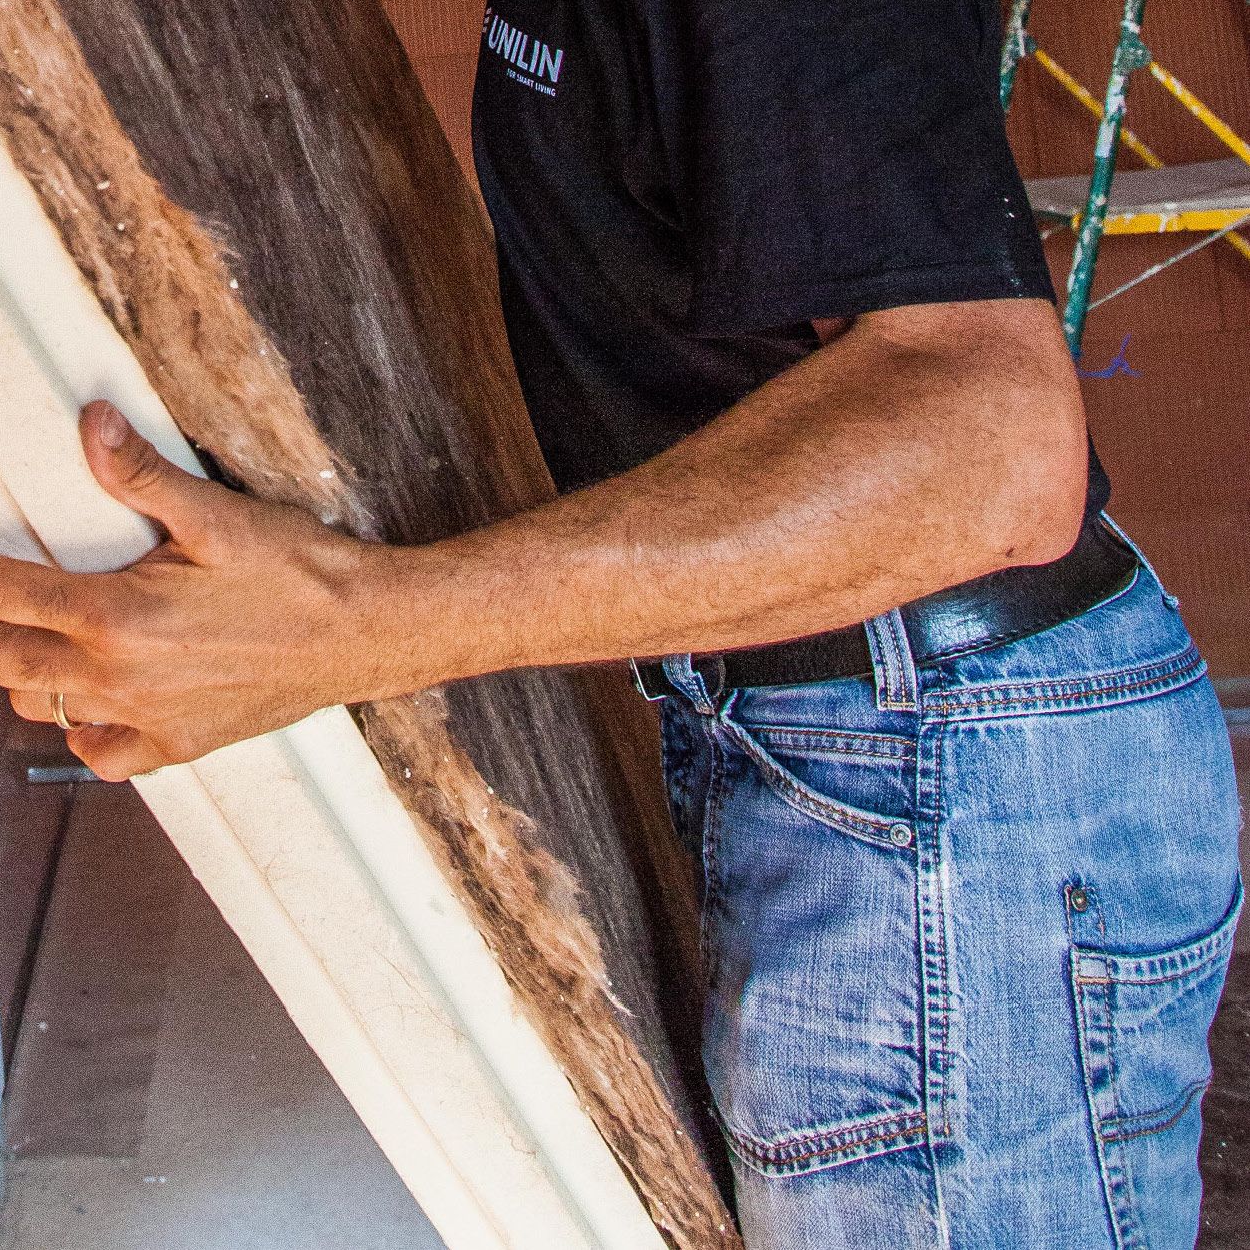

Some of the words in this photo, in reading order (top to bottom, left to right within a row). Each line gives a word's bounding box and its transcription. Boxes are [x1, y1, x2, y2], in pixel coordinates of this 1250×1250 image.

[488, 15, 564, 83] UNILIN
[516, 73, 535, 89] SMART
[535, 82, 556, 97] LIVING
